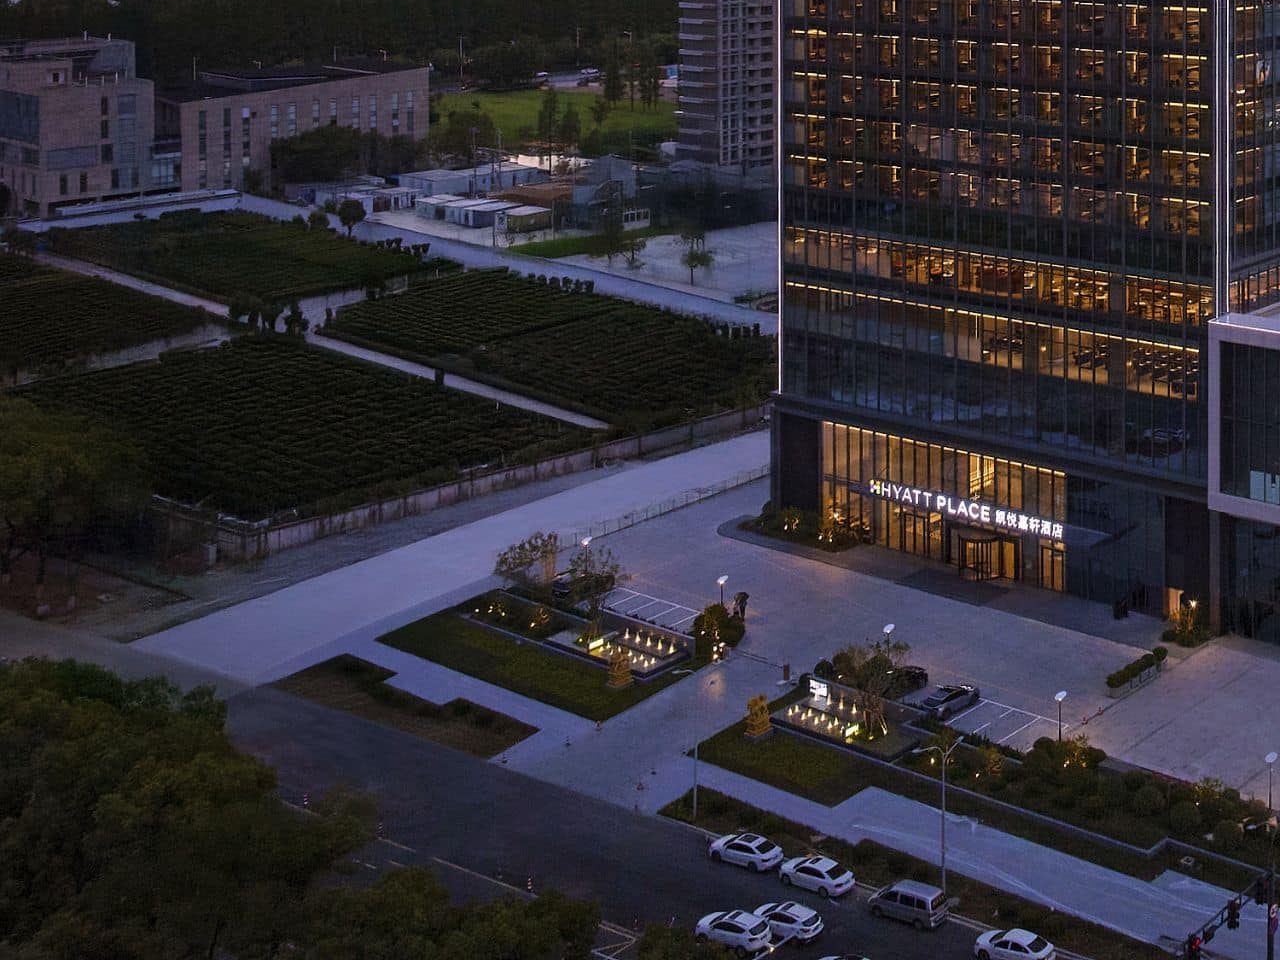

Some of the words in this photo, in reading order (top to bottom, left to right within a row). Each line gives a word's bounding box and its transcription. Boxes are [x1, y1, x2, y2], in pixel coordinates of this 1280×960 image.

[881, 482, 932, 508] HYATT
[937, 496, 991, 522] PLACE
[995, 510, 1064, 539] 凯悦嘉轩酒店
